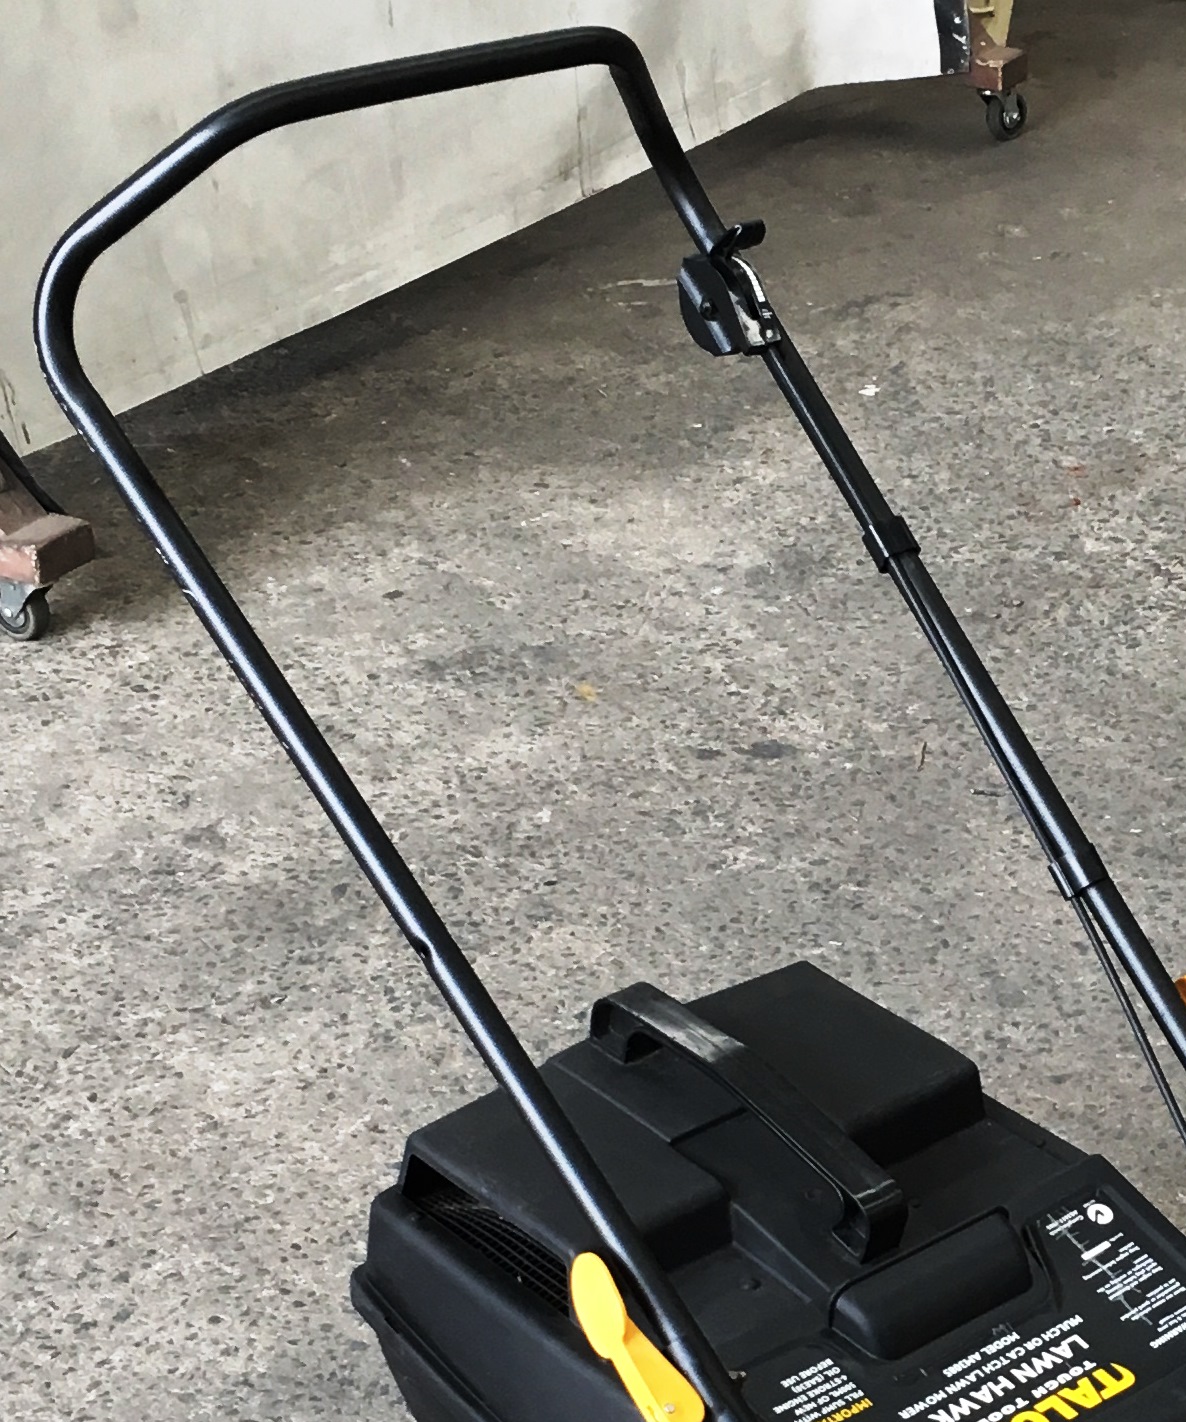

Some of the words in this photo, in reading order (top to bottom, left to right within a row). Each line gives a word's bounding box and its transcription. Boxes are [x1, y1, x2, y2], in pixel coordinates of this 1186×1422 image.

[1040, 1314, 1083, 1342] MULCH
[979, 1331, 1020, 1355] MODEL
[1022, 1335, 1043, 1351] OR
[980, 1345, 1026, 1375] CATCH
[1009, 1333, 1089, 1383] LAWN
[797, 1358, 834, 1379] BEFORE
[822, 1365, 841, 1378] OIL
[779, 1374, 800, 1387] USE
[943, 1368, 984, 1395] LAWN
[1030, 1361, 1096, 1398] TOUGH
[772, 1394, 808, 1414] ENGINE
[815, 1394, 831, 1405] OF
[843, 1389, 864, 1402] FILL
[897, 1389, 947, 1420] MOWER
[793, 1401, 817, 1416] NEW
[819, 1398, 846, 1414] SUMP
